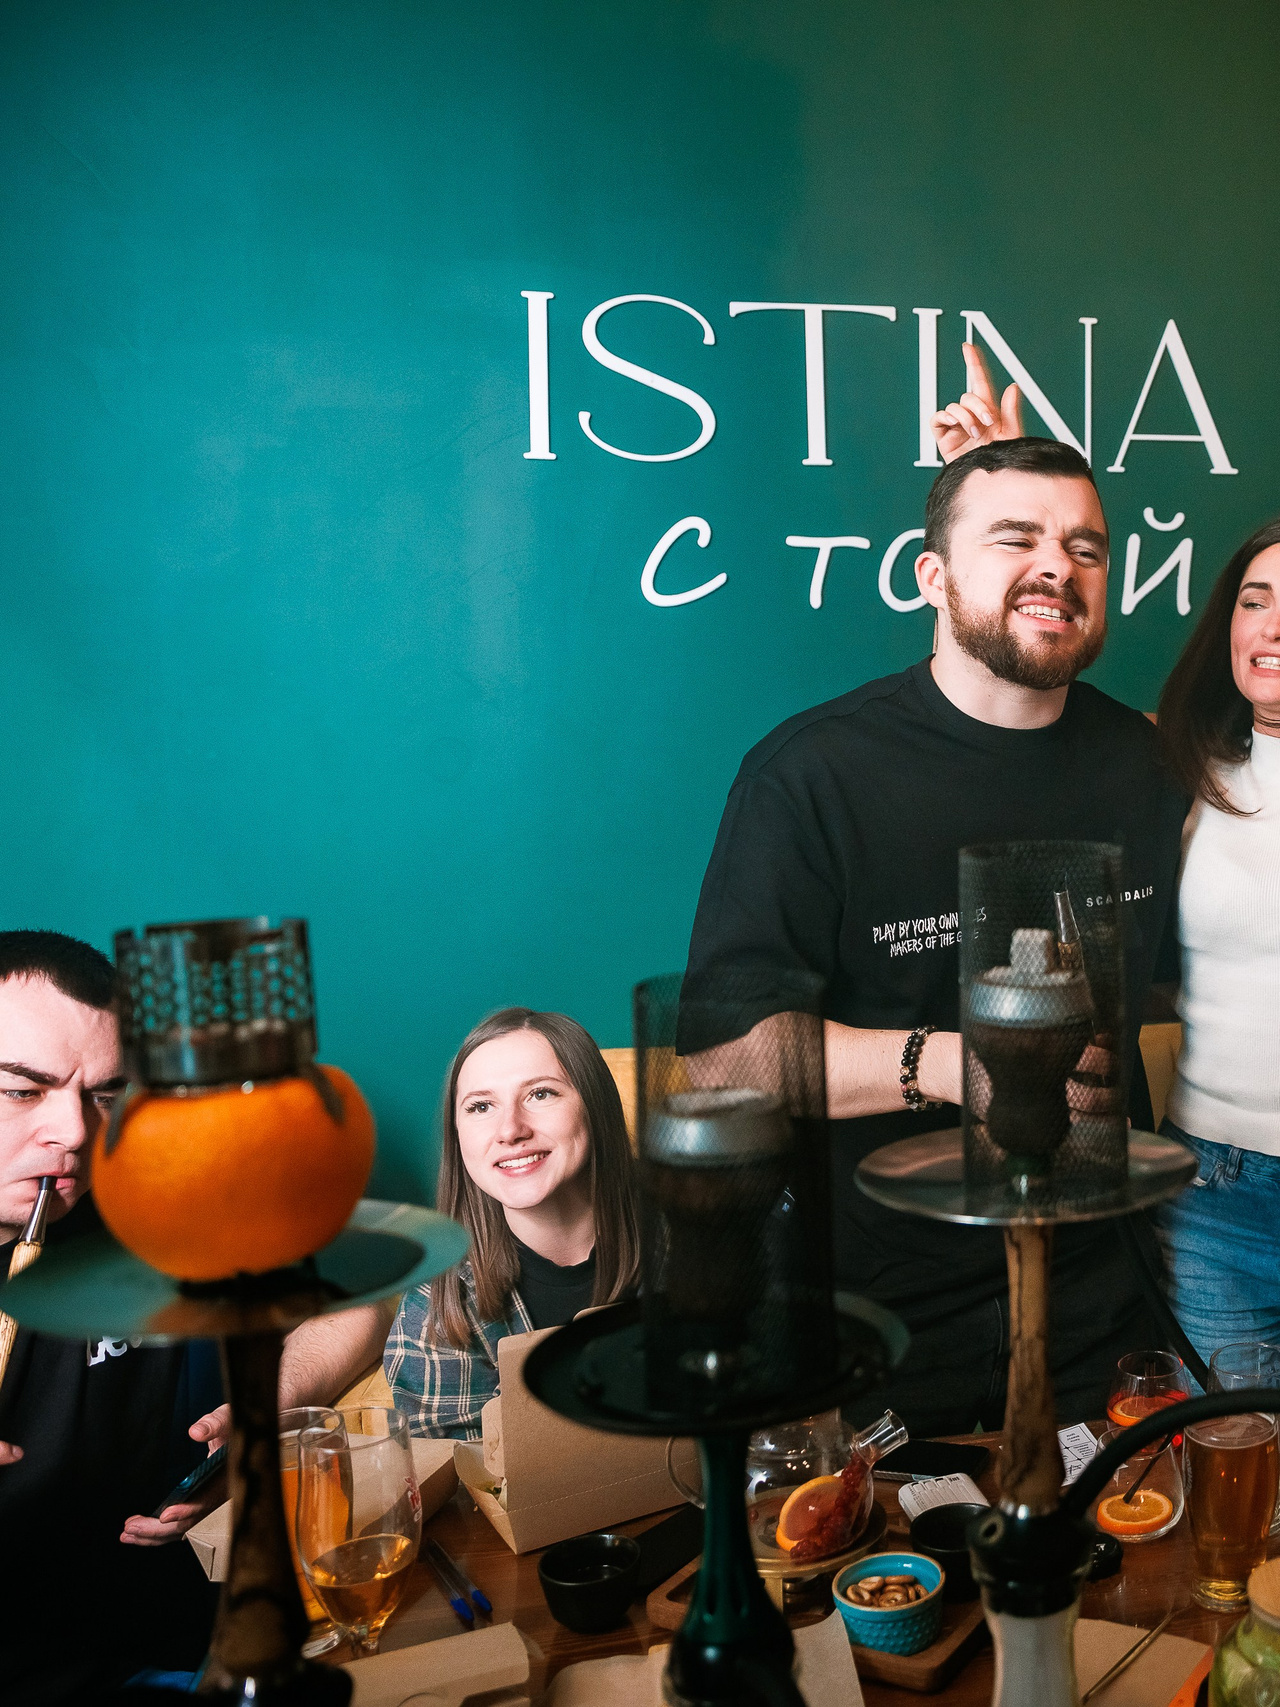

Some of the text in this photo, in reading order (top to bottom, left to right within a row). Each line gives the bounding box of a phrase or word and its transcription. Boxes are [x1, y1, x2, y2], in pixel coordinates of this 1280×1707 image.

[521, 290, 1239, 475] ISTINA
[872, 922, 896, 944] PLAY
[899, 919, 911, 939] BY
[911, 917, 939, 938] YOUR
[938, 911, 959, 931] OWN
[890, 937, 923, 958] MAKERS
[925, 935, 937, 950] OF
[938, 931, 955, 948] THE
